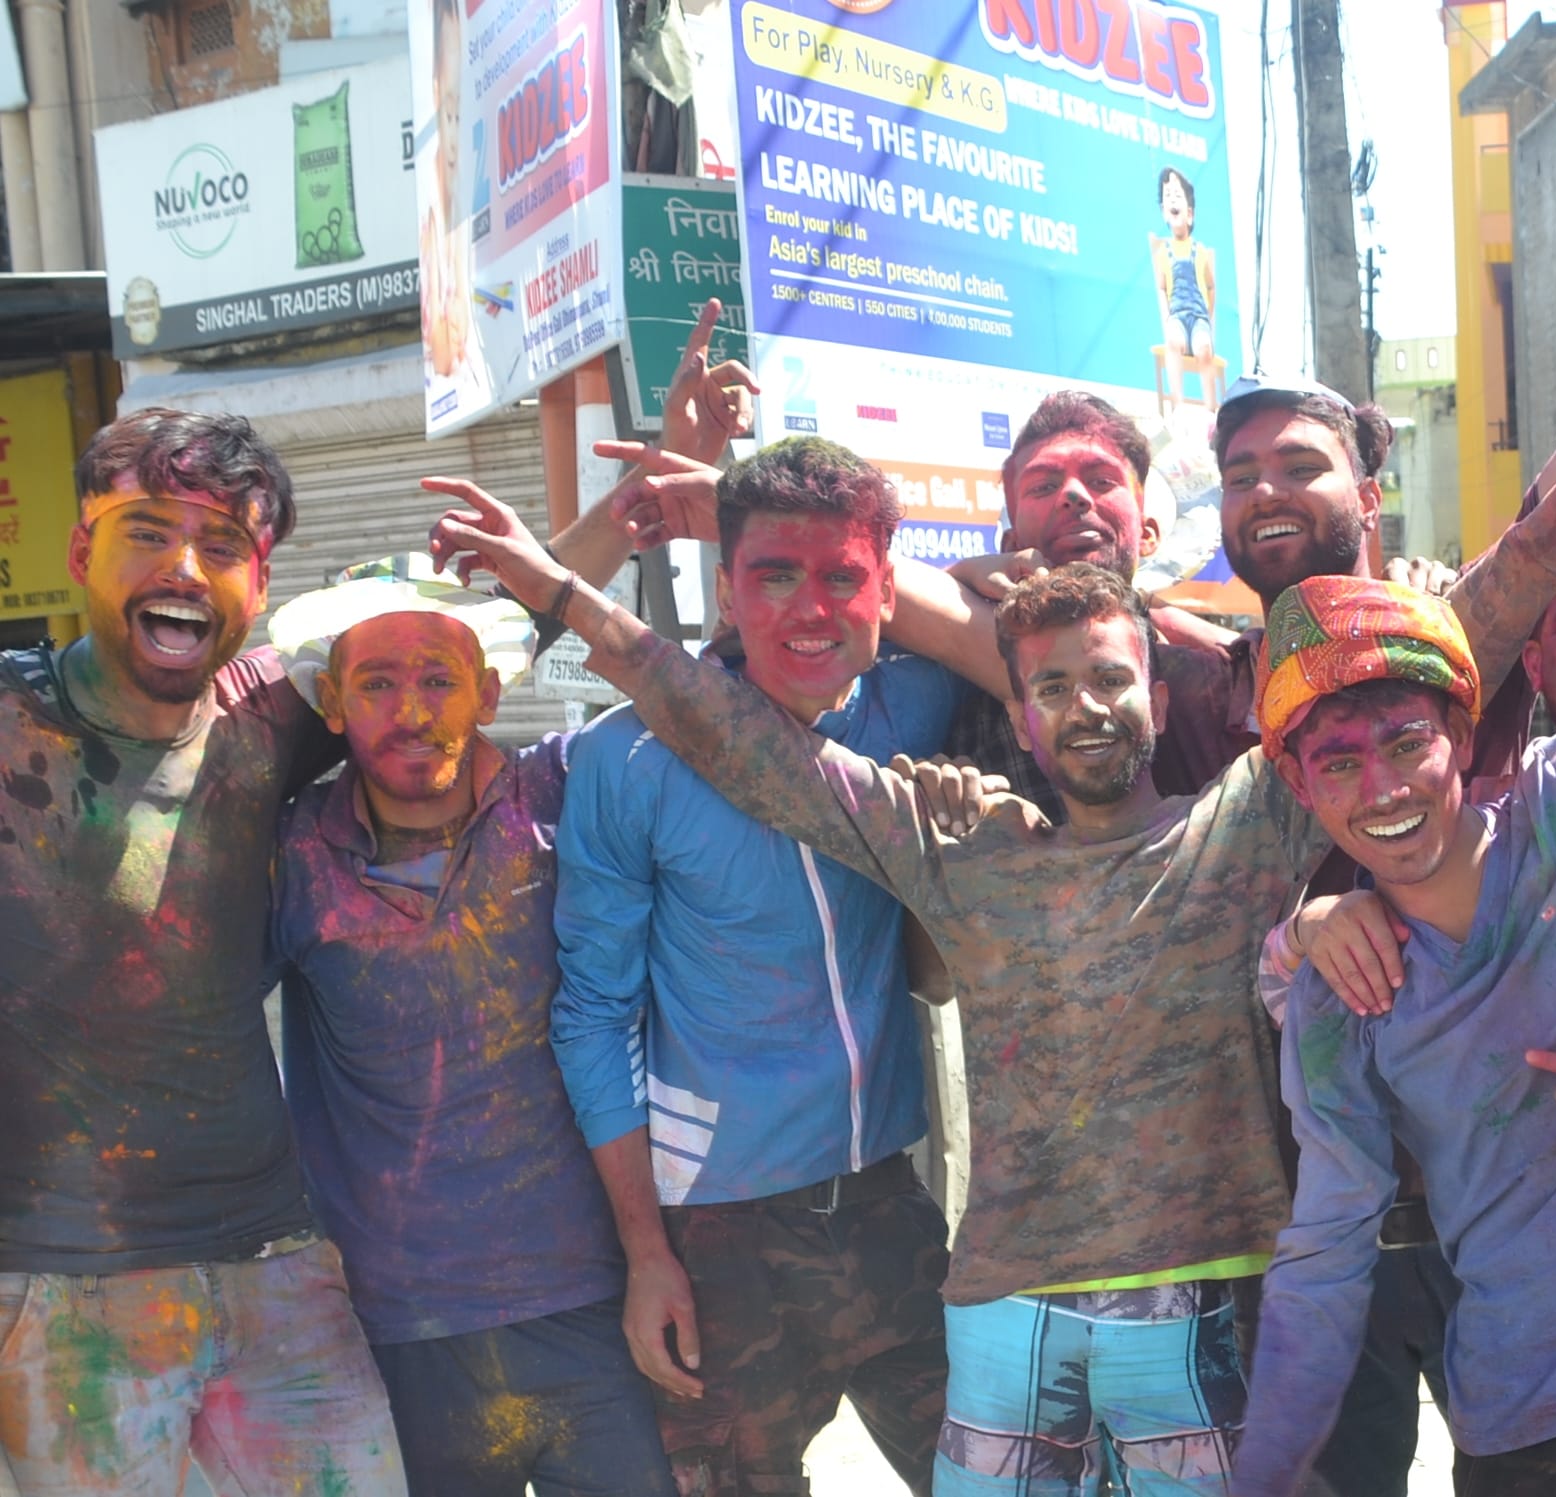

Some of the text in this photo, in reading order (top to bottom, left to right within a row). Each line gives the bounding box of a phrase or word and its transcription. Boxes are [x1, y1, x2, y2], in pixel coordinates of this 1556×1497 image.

[752, 16, 790, 51] For
[798, 29, 848, 74] Play,
[856, 48, 935, 100] Nursery
[941, 74, 954, 100] &
[498, 32, 588, 187] KIDZEE
[755, 85, 1047, 194] KIDZEE, THE FAVOURITE
[154, 171, 248, 218] NUVOCO
[156, 213, 192, 231] Shaping
[202, 209, 221, 222] new
[761, 152, 1079, 255] LEARNING PLACE OF KIDS!
[765, 204, 868, 242] Enrol your kid in
[525, 266, 559, 319] KIDZEE
[559, 238, 599, 298] SHAMLI
[628, 246, 661, 284] श्री
[769, 234, 1009, 302] Asia's largest preschool chain.
[195, 295, 269, 334] SINGHAL
[270, 281, 352, 319] TRADERS
[808, 289, 855, 312] CENTRES
[548, 658, 606, 686] 75798
